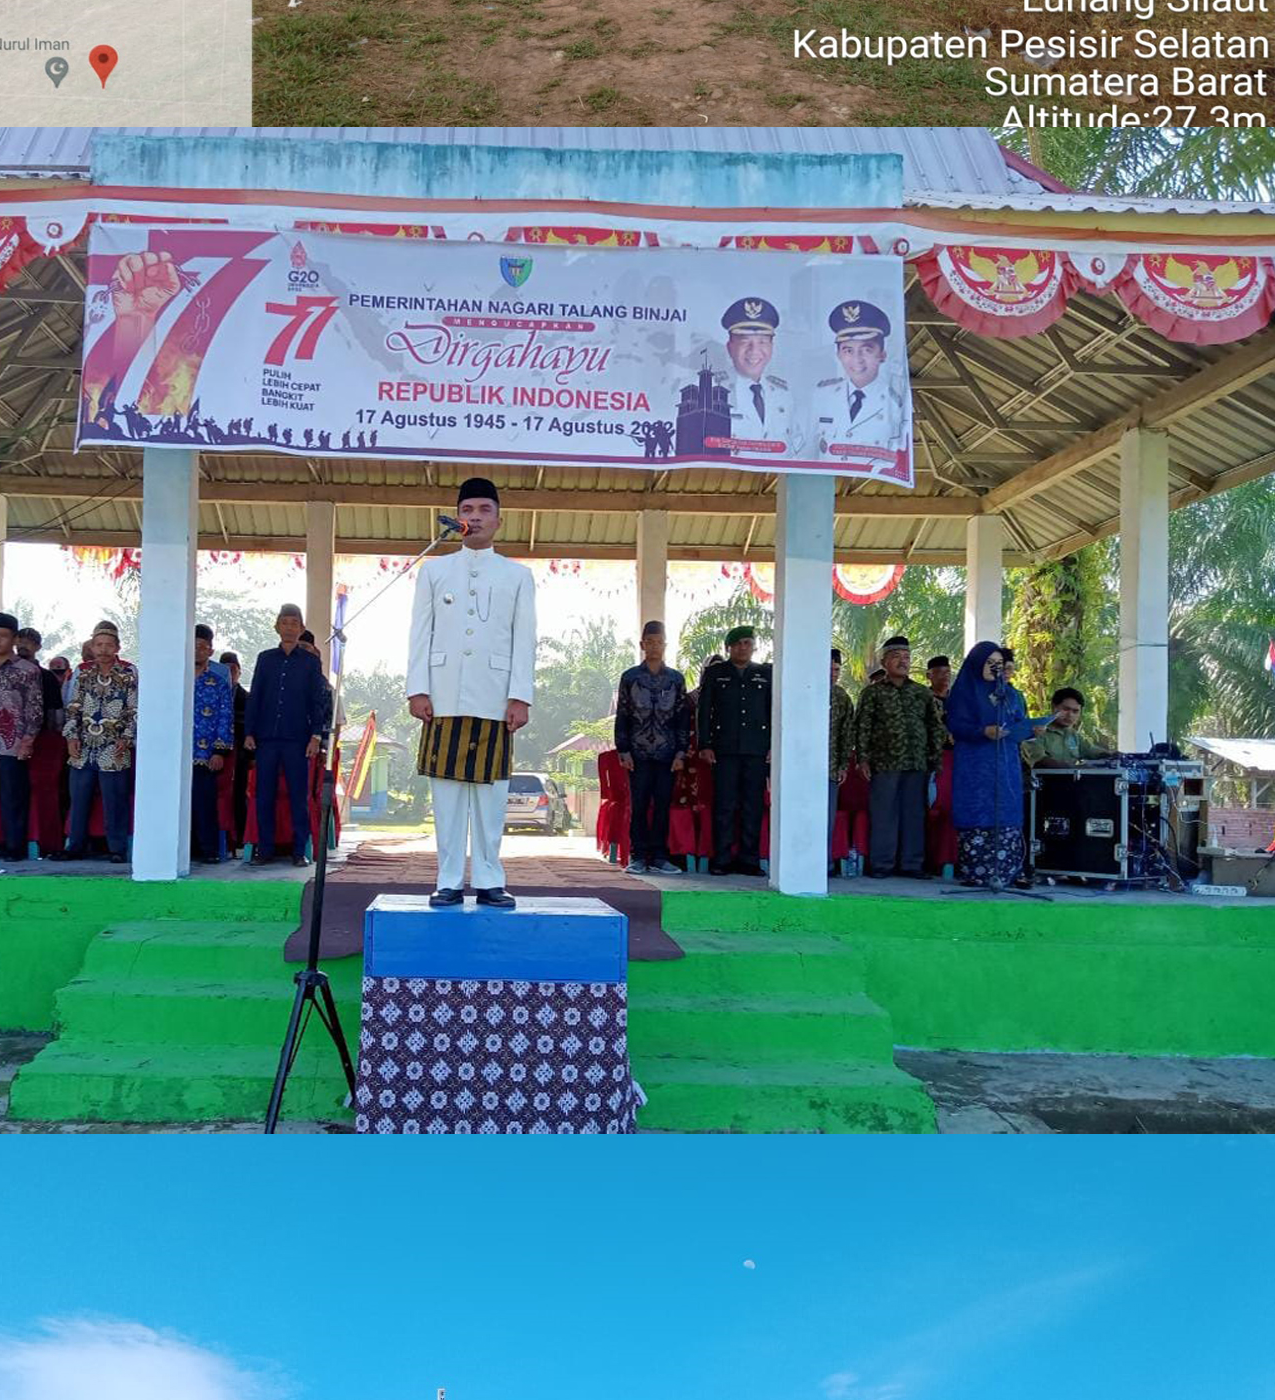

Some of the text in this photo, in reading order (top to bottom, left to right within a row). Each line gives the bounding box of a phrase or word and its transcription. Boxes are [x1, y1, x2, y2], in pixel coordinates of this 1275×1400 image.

[288, 270, 320, 284] G20
[349, 293, 687, 322] PEMERINTAHAN NAGARI TALANG BINJAI
[264, 295, 341, 366] 77
[453, 318, 585, 330] MENGUCAPKAN
[386, 320, 612, 386] Dirgahayu
[263, 368, 292, 380] PULIH
[262, 378, 322, 392] LEBIH CEPAT
[261, 388, 304, 401] BANGKIT
[378, 381, 651, 412] REPUBLIK INDONESIA
[261, 397, 316, 412] LEBIH KUAT
[356, 409, 377, 424] 17
[381, 411, 457, 430] Agustus
[463, 414, 506, 430] 1945
[523, 416, 544, 432] 17
[548, 417, 625, 437] Agustus
